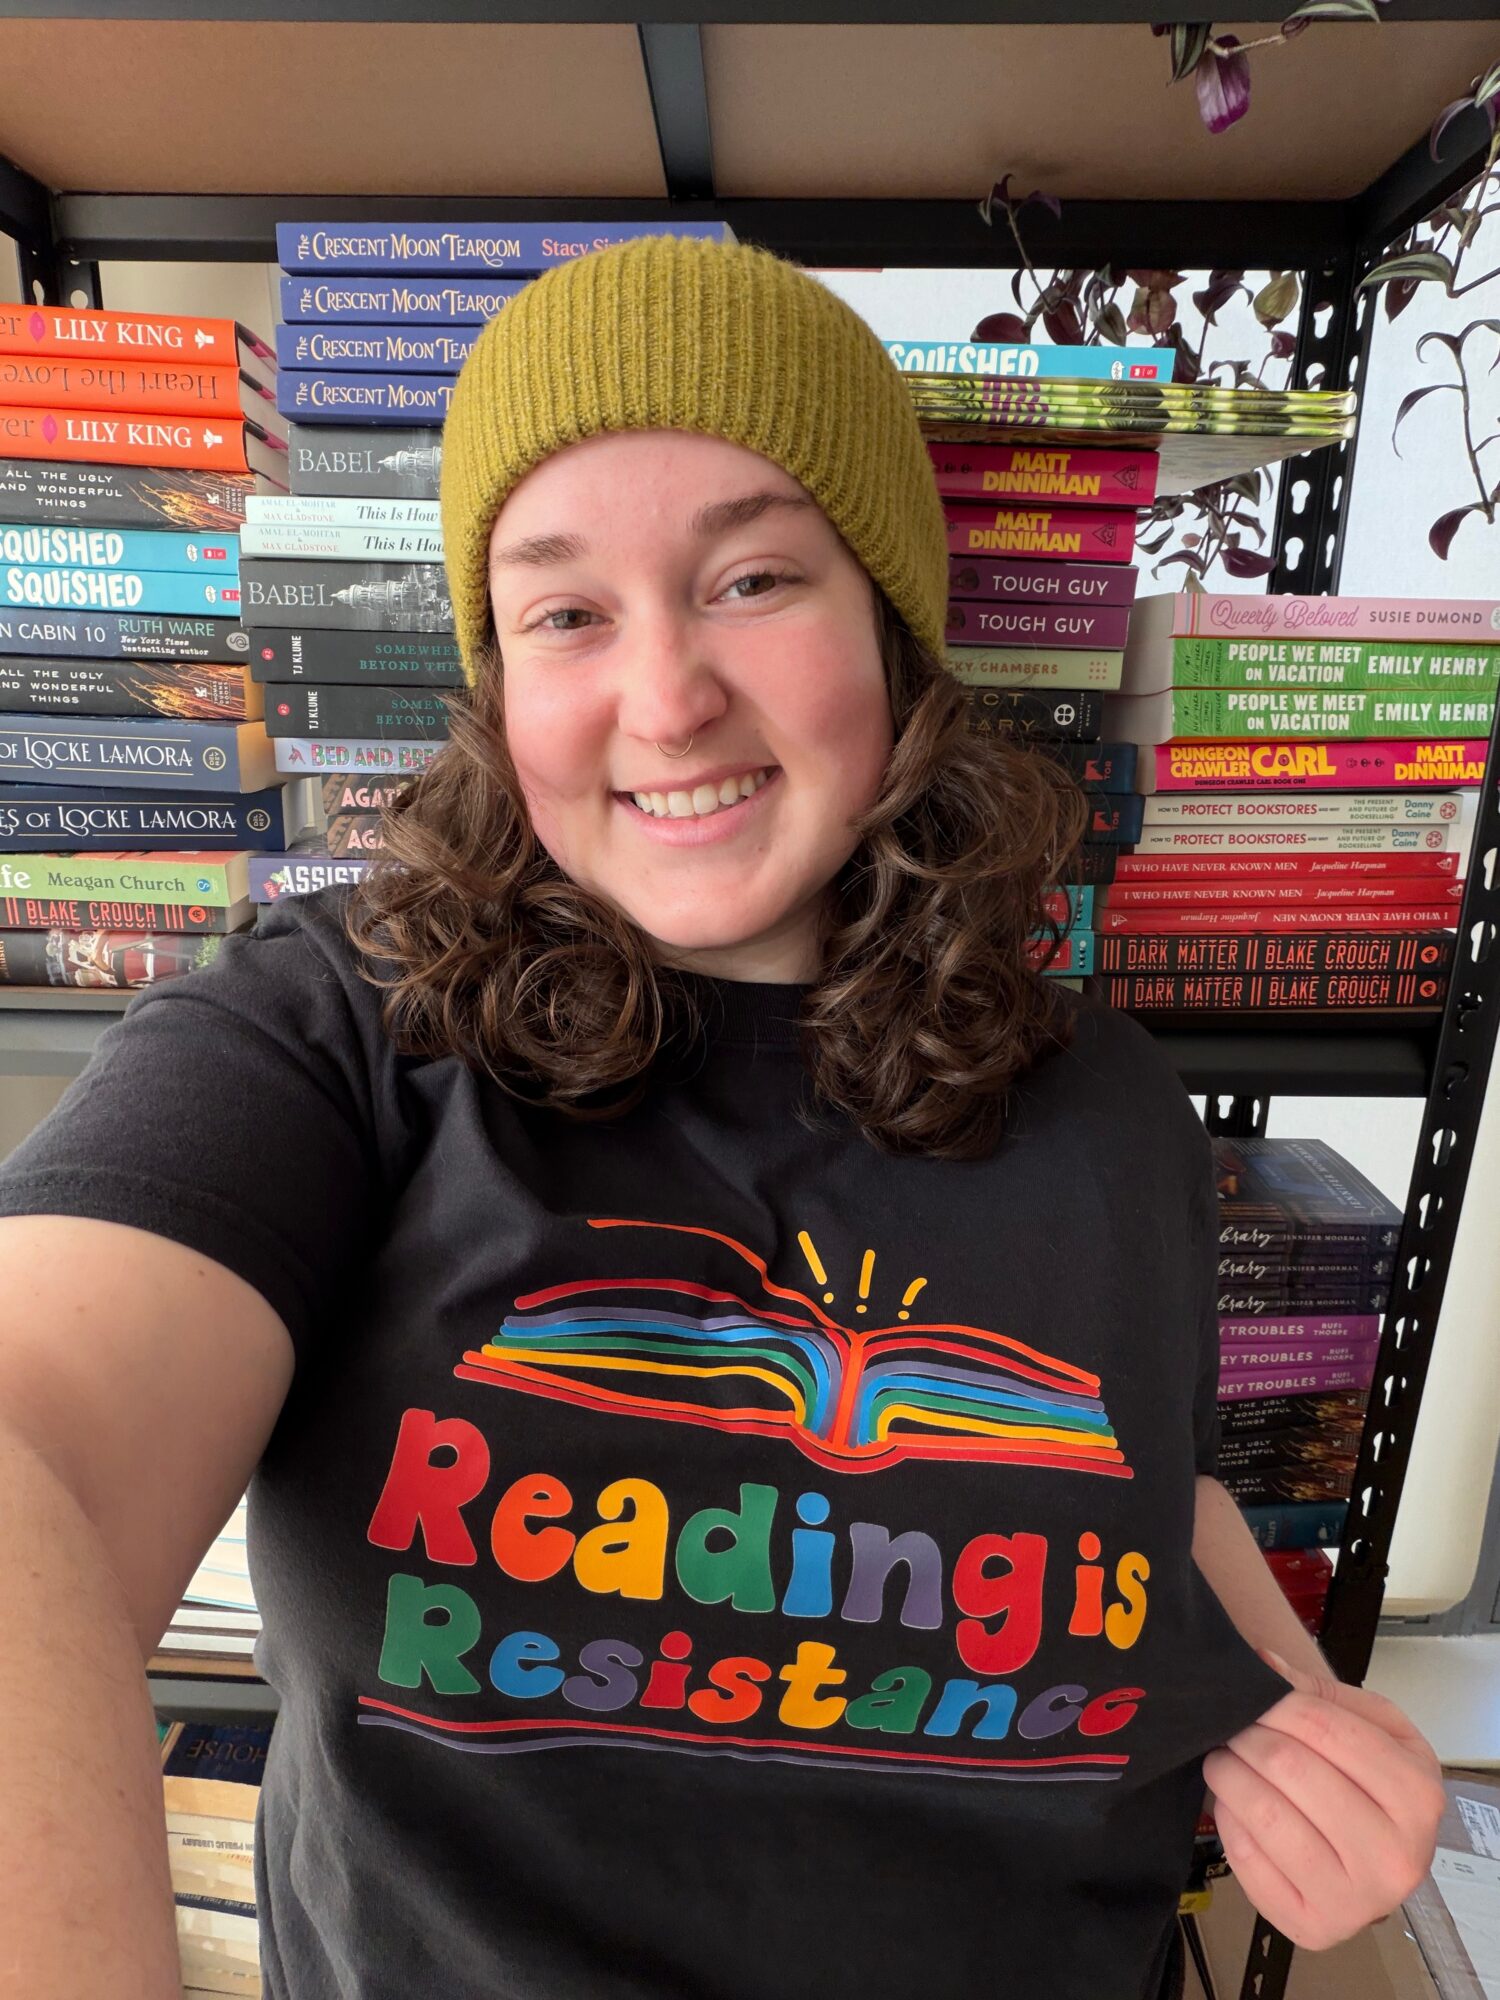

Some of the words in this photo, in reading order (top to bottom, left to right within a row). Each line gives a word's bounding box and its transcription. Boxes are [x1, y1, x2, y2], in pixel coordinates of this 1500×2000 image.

[312, 232, 388, 259] CRESCENT
[390, 233, 440, 260] MOON
[441, 233, 522, 268] TEAROOM
[315, 286, 390, 313] CRESCENT
[391, 288, 441, 314] MOON
[54, 317, 109, 343] LILY
[117, 321, 184, 349] KING
[310, 334, 384, 361] CRESCENT
[385, 336, 435, 362] MOON
[138, 370, 218, 400] Heart
[310, 380, 385, 407] CRESCENT
[387, 384, 437, 409] MOON
[65, 418, 122, 445] LILY
[126, 424, 193, 450] KING
[298, 447, 381, 475] BABEL
[1010, 451, 1072, 473] MATT
[6, 469, 32, 479] ALL
[40, 470, 68, 481] THE
[78, 473, 114, 484] UGLY
[982, 471, 1101, 497] DINNIMAN
[37, 485, 123, 498] WONDERFUL
[35, 498, 87, 509] THINGS
[357, 505, 387, 521] This
[390, 507, 403, 521] Is
[994, 511, 1053, 532] MATT
[363, 536, 397, 552] This
[400, 539, 413, 553] Is
[967, 529, 1082, 554] DINNIMAN
[248, 581, 334, 607] BABEL
[992, 575, 1061, 595] TOUGH
[1067, 579, 1110, 597] GUY
[978, 613, 1047, 633] TOUGH
[1054, 617, 1097, 635] GUY
[1210, 600, 1279, 632] Queerly
[1284, 599, 1361, 630] Beloved
[1369, 610, 1411, 624] SUSIE
[1416, 612, 1483, 626] DUMOND
[18, 622, 76, 643] CABIN
[84, 625, 107, 644] 10
[118, 618, 163, 635] RUTH
[168, 621, 216, 638] WARE
[291, 635, 302, 662] KLUNE
[1227, 643, 1288, 663] PEOPLE
[1291, 645, 1317, 663] WE
[1319, 645, 1362, 665] MEET
[33, 669, 60, 679] THE
[70, 671, 105, 681] UGLY
[360, 659, 420, 672] BEYOND
[979, 660, 1059, 675] CHAMBERS
[1245, 667, 1262, 682] ON
[1268, 664, 1346, 684] VACATION
[1367, 655, 1424, 676] EMILY
[1429, 656, 1489, 677] HENRY
[30, 682, 115, 694] WONDERFUL
[30, 694, 81, 705] THINGS
[308, 690, 318, 717] KLUNE
[1227, 694, 1288, 714] PEOPLE
[1291, 696, 1318, 714] WE
[1321, 694, 1367, 715] MEET
[1374, 702, 1432, 722] EMILY
[1246, 717, 1264, 731] ON
[1270, 713, 1351, 733] VACATION
[24, 736, 93, 769] LOCKE
[100, 745, 194, 768] LAMORA
[311, 744, 350, 768] BED
[354, 747, 394, 768] AND
[1170, 746, 1250, 762] DUNGEON
[1251, 745, 1338, 777] CARL
[1416, 745, 1466, 763] MATT
[1170, 760, 1251, 778] CRAWLER
[1181, 804, 1233, 817] PROTECT
[1237, 804, 1318, 816] BOOKSTORES
[1404, 799, 1434, 811] Danny
[1405, 809, 1431, 818] Caine
[25, 811, 51, 830] OF
[58, 805, 130, 838] LOCKE
[139, 808, 240, 831] LAMORA
[1174, 834, 1224, 845] PROTECT
[1228, 834, 1307, 845] BOOKSTORES
[1391, 828, 1421, 840] Danny
[1392, 837, 1418, 847] Caine
[1131, 864, 1159, 873] WHO
[1162, 863, 1190, 872] HAVE
[1192, 863, 1226, 872] NEVER
[1230, 862, 1272, 872] KNOWN
[1274, 862, 1298, 871] MEN
[1309, 862, 1349, 873] Jacqueline
[1350, 861, 1387, 872] Harpman
[47, 870, 114, 890] Meagan
[119, 872, 185, 891] Church
[1132, 891, 1160, 900] WHO
[1163, 891, 1192, 899] HAVE
[1194, 891, 1229, 899] NEVER
[1233, 889, 1276, 899] KNOWN
[1279, 889, 1303, 898] MEN
[1314, 889, 1355, 900] Jacqueline
[1357, 888, 1395, 899] Harpman
[26, 900, 82, 925] BLAKE
[90, 901, 156, 927] CROUCH
[1128, 942, 1168, 968] DARK
[1177, 942, 1238, 968] MATTER
[1265, 942, 1318, 968] BLAKE
[1325, 942, 1391, 968] CROUCH
[1135, 980, 1175, 1005] DARK
[1183, 980, 1243, 1004] MATTER
[1269, 979, 1319, 1003] BLAKE
[1327, 978, 1391, 1002] CROUCH
[1229, 1325, 1305, 1336] TROUBLES
[1242, 1352, 1313, 1365] TROUBLES
[1247, 1377, 1317, 1393] TROUBLES
[366, 1407, 1049, 1676] Reading
[1068, 1530, 1151, 1650] is
[377, 1572, 1148, 1741] Resistance
